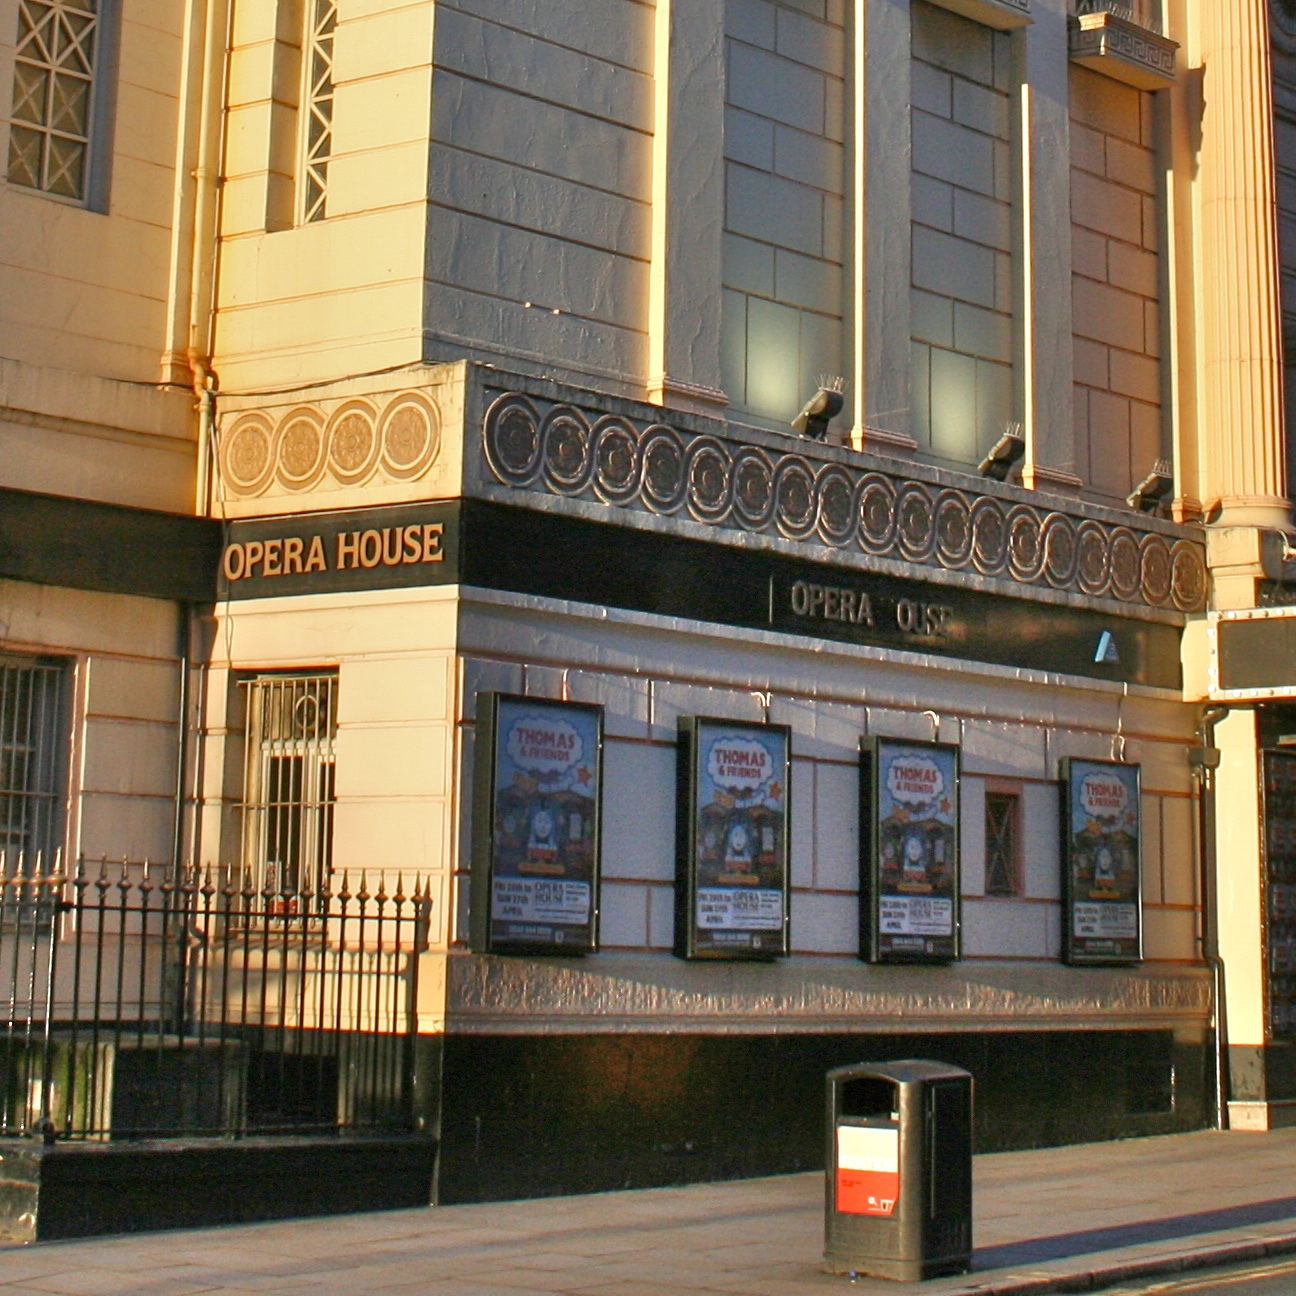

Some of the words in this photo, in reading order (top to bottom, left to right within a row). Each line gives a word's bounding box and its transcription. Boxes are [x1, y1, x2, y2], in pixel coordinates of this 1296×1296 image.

[223, 534, 329, 582] OPERA
[336, 522, 444, 571] HOUSE
[791, 579, 875, 627] OPERA
[879, 596, 954, 637] OUSE
[516, 727, 576, 750] THOMAS
[714, 748, 767, 767] THOMAS
[893, 765, 937, 783] THOMAS
[1085, 782, 1124, 799] THOMAS
[534, 881, 563, 893] OPERA
[534, 893, 563, 904] HOUSE
